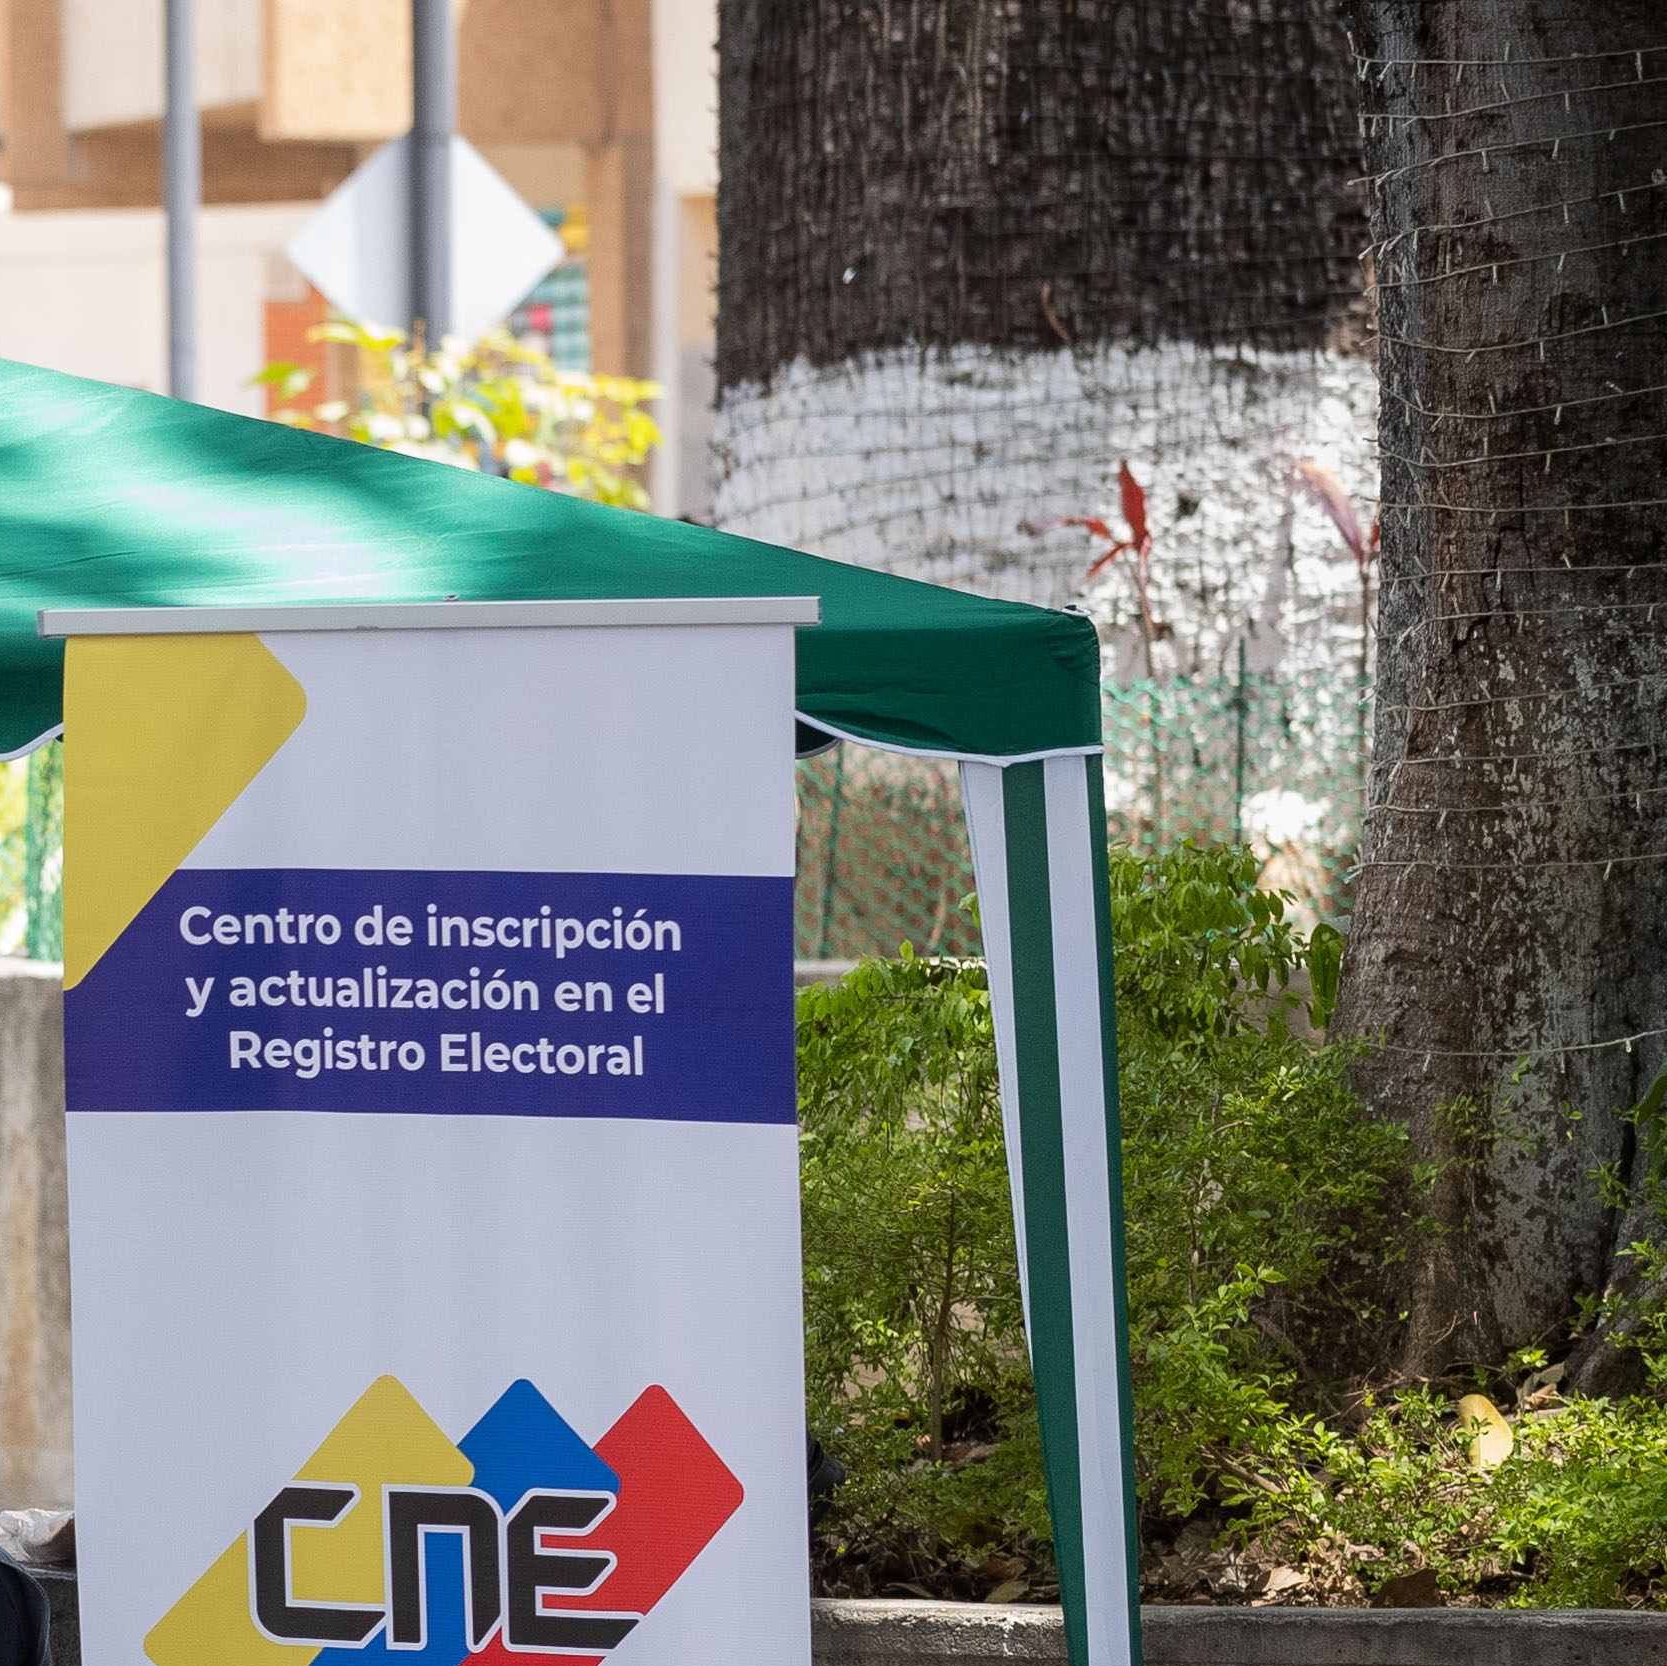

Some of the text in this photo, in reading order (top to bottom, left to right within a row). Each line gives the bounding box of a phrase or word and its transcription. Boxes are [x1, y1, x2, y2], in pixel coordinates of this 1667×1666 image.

[179, 902, 683, 959] Centro de inscripción
[184, 965, 665, 1018] y actualización en el
[229, 1026, 644, 1079] Registro Electoral
[251, 1486, 642, 1653] CNE
